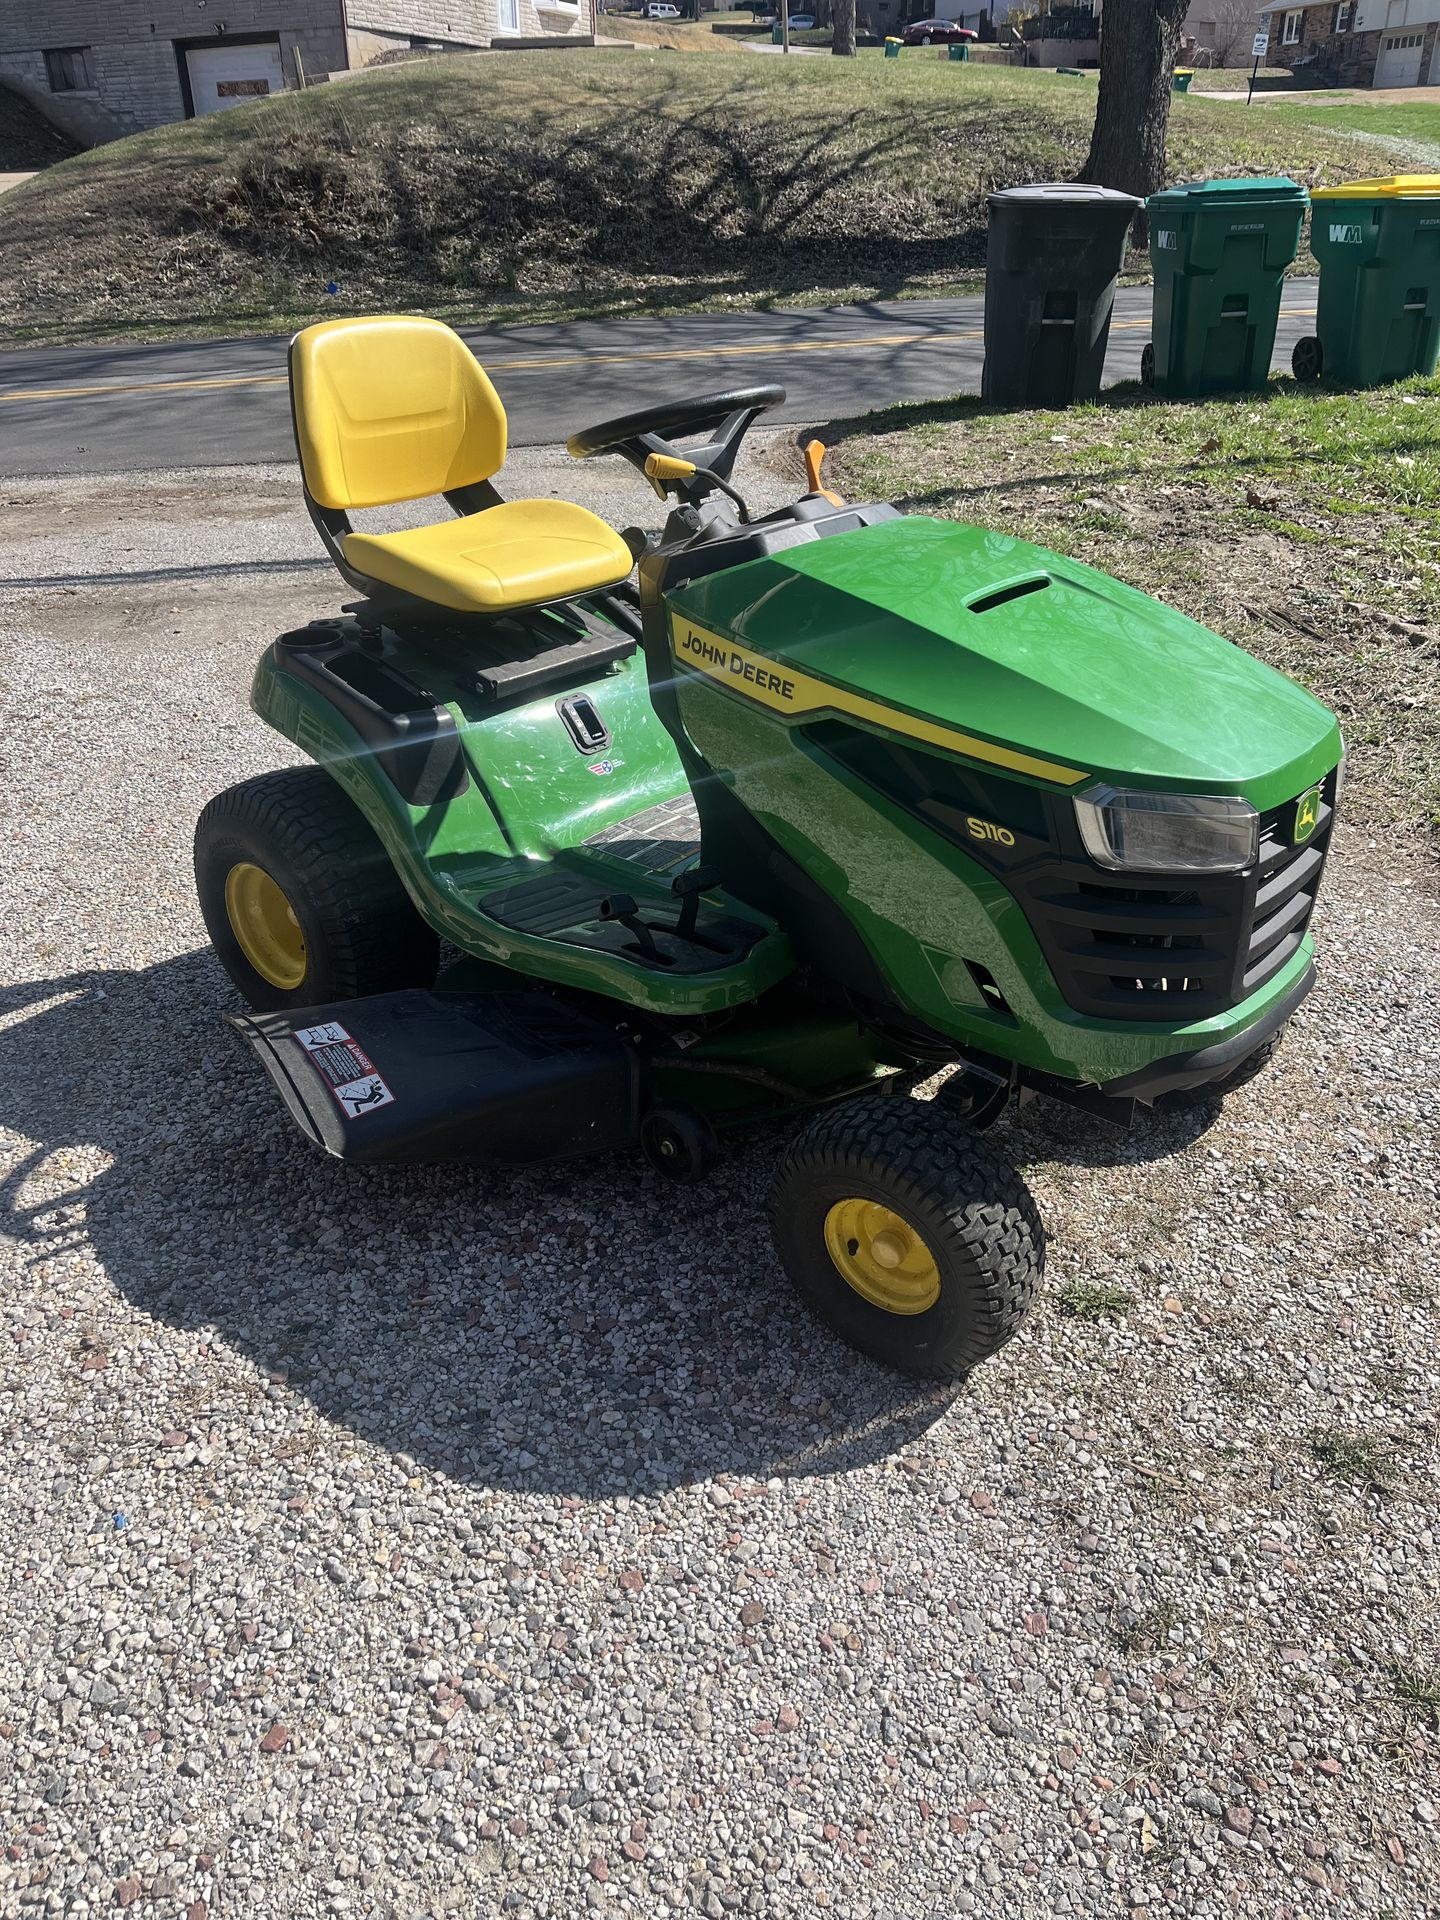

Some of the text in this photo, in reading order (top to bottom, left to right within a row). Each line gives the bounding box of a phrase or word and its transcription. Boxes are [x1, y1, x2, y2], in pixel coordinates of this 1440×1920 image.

[1157, 230, 1177, 250] WM
[1329, 224, 1363, 244] WM
[682, 630, 795, 700] JOHN DEERE
[966, 816, 1015, 846] S110
[351, 1047, 373, 1070] DANGER
